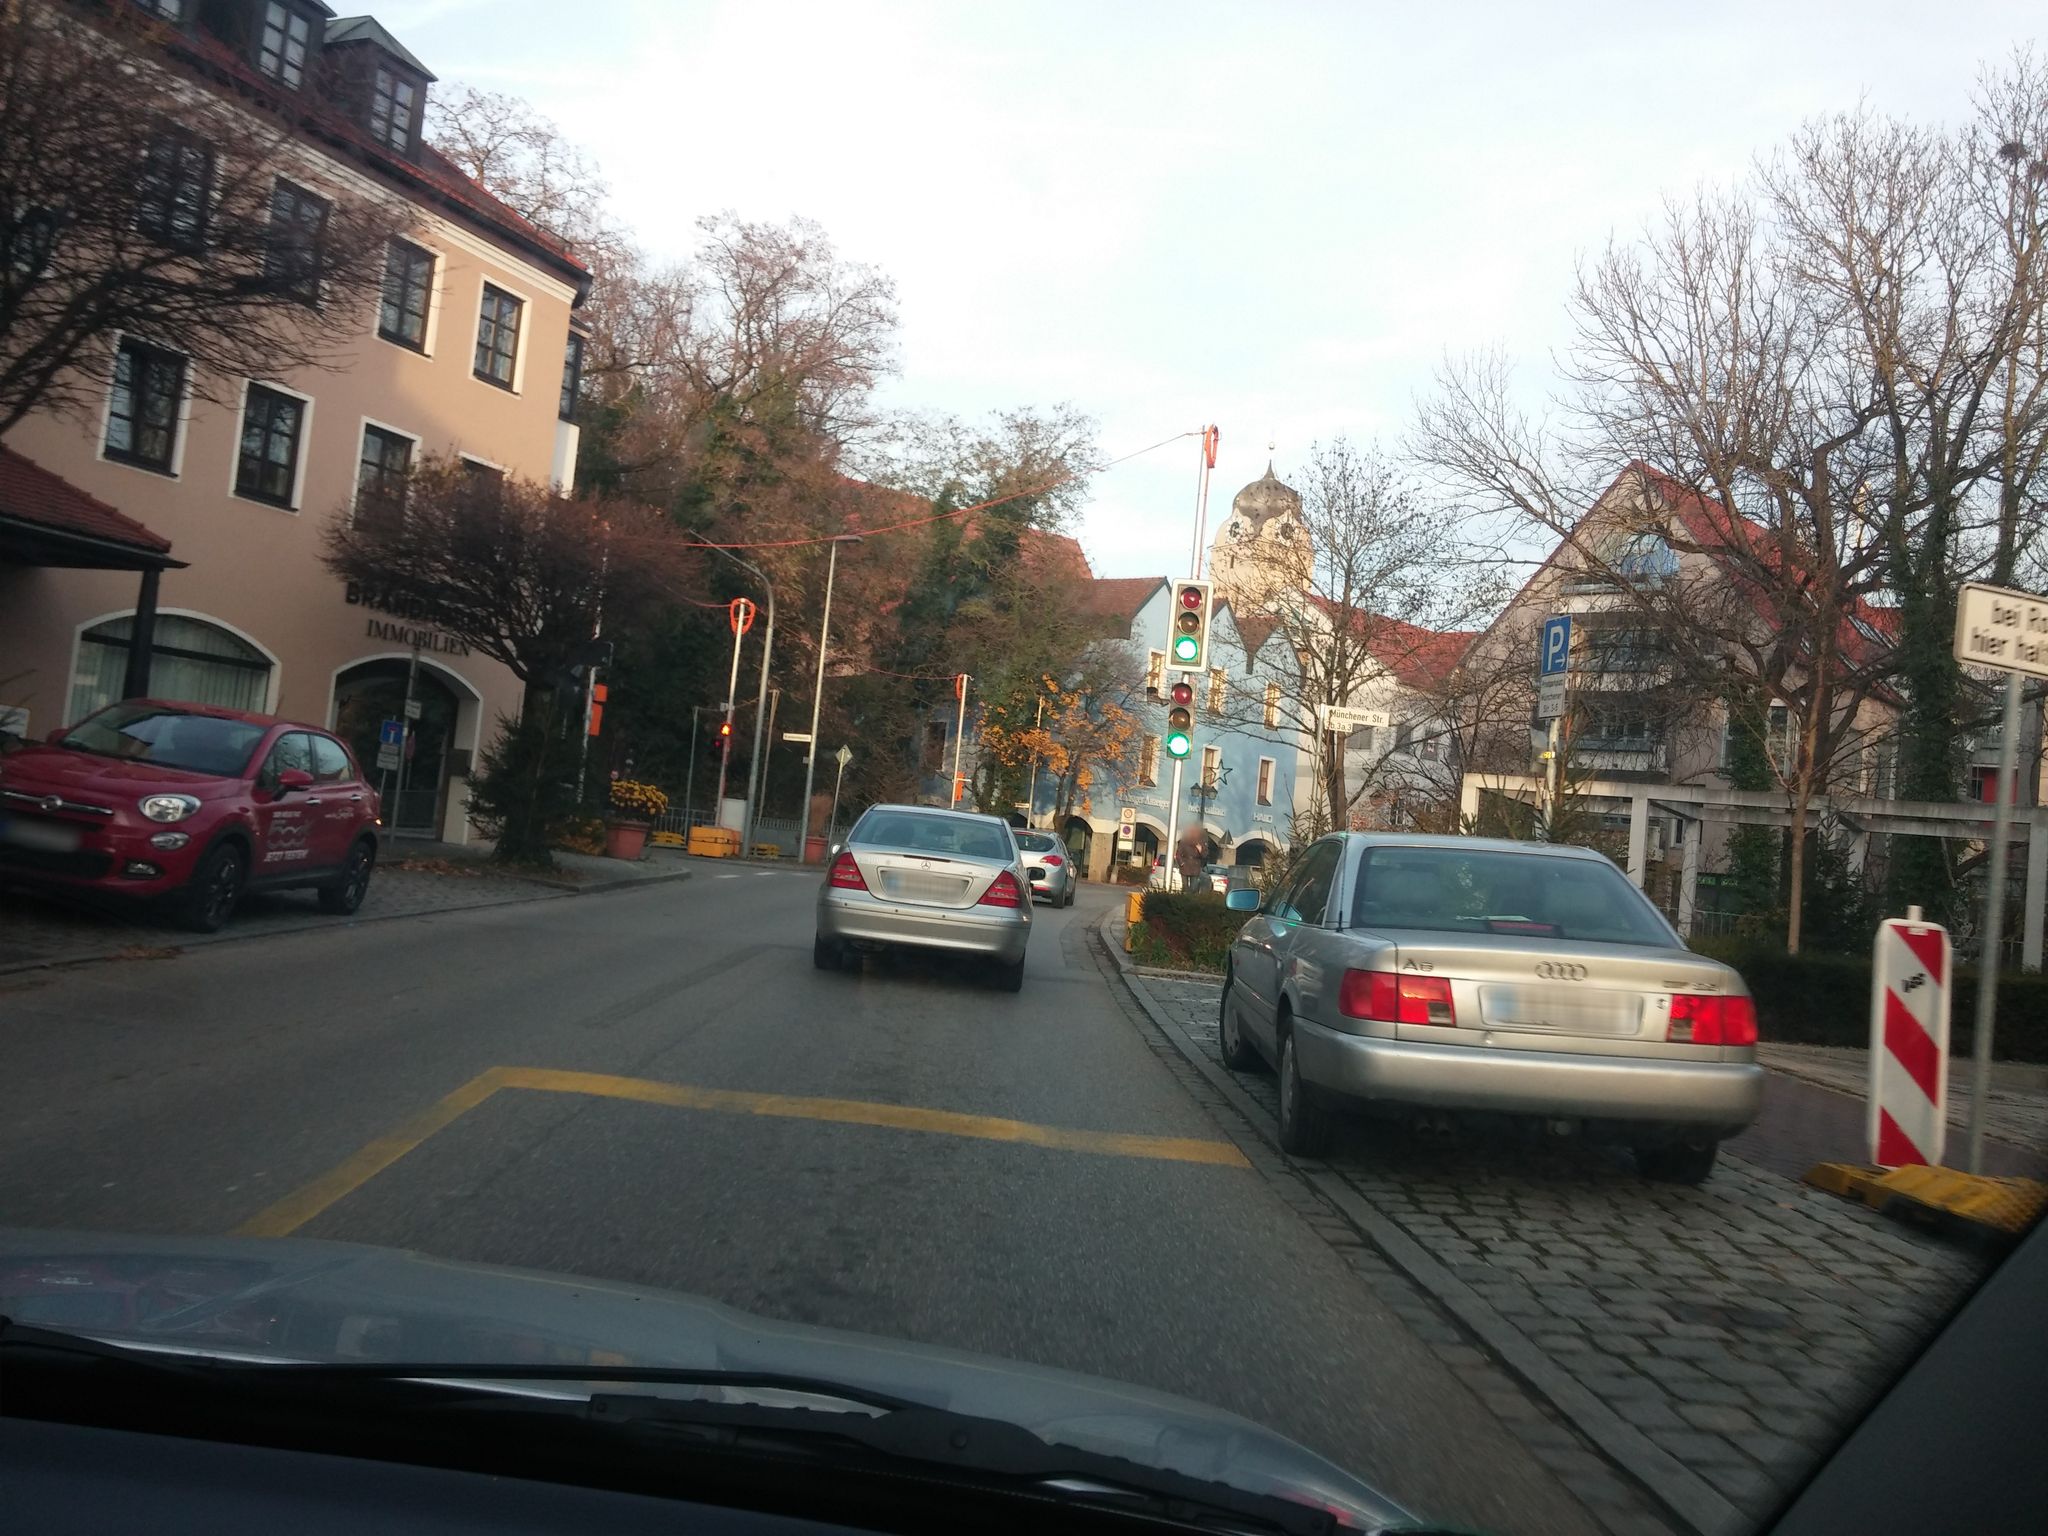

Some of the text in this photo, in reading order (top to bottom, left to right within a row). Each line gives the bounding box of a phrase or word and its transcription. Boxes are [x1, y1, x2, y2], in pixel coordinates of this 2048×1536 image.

[1991, 600, 2021, 628] bei
[366, 619, 471, 657] IMMOBILIEN
[1547, 625, 1564, 671] P
[1970, 626, 2008, 656] hier
[1329, 709, 1384, 724] Münchener Str.
